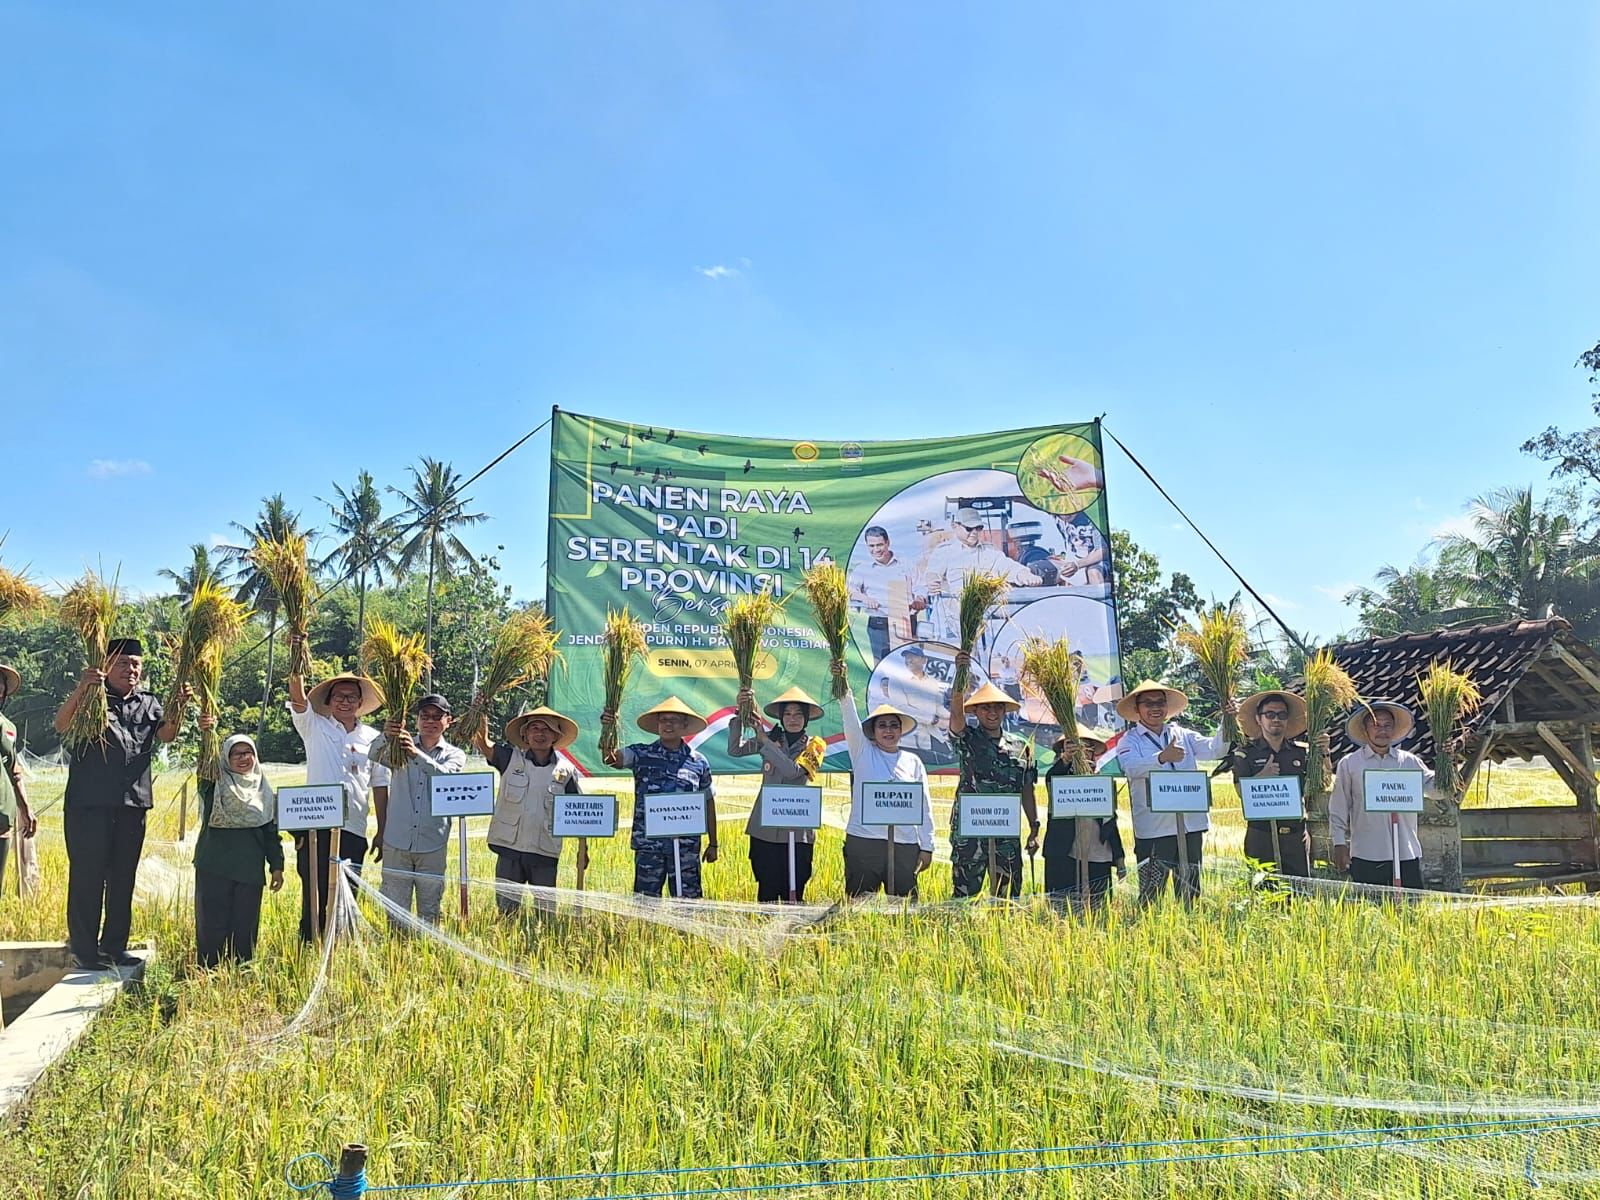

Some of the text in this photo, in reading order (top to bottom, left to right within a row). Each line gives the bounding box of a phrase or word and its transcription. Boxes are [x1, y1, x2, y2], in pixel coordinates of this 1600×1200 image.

[592, 482, 812, 514] PANEN RAYA
[657, 514, 738, 540] PADI
[567, 537, 834, 570] SERENTAK DI 14
[621, 568, 782, 597] PROVINSI
[692, 638, 705, 646] H.
[658, 658, 692, 668] SENIN,
[694, 660, 708, 668] 07
[710, 660, 737, 668] APRIL
[436, 785, 488, 793] DPKP
[1158, 785, 1182, 793] KEPALA
[1250, 784, 1288, 793] KEPALA
[291, 796, 334, 804] KEPALA DINAS
[874, 792, 912, 800] BUPATI
[564, 802, 604, 810] SEKRETARIS
[772, 808, 810, 816] GUNUNGKIDUL
[970, 808, 992, 816] DANDIM
